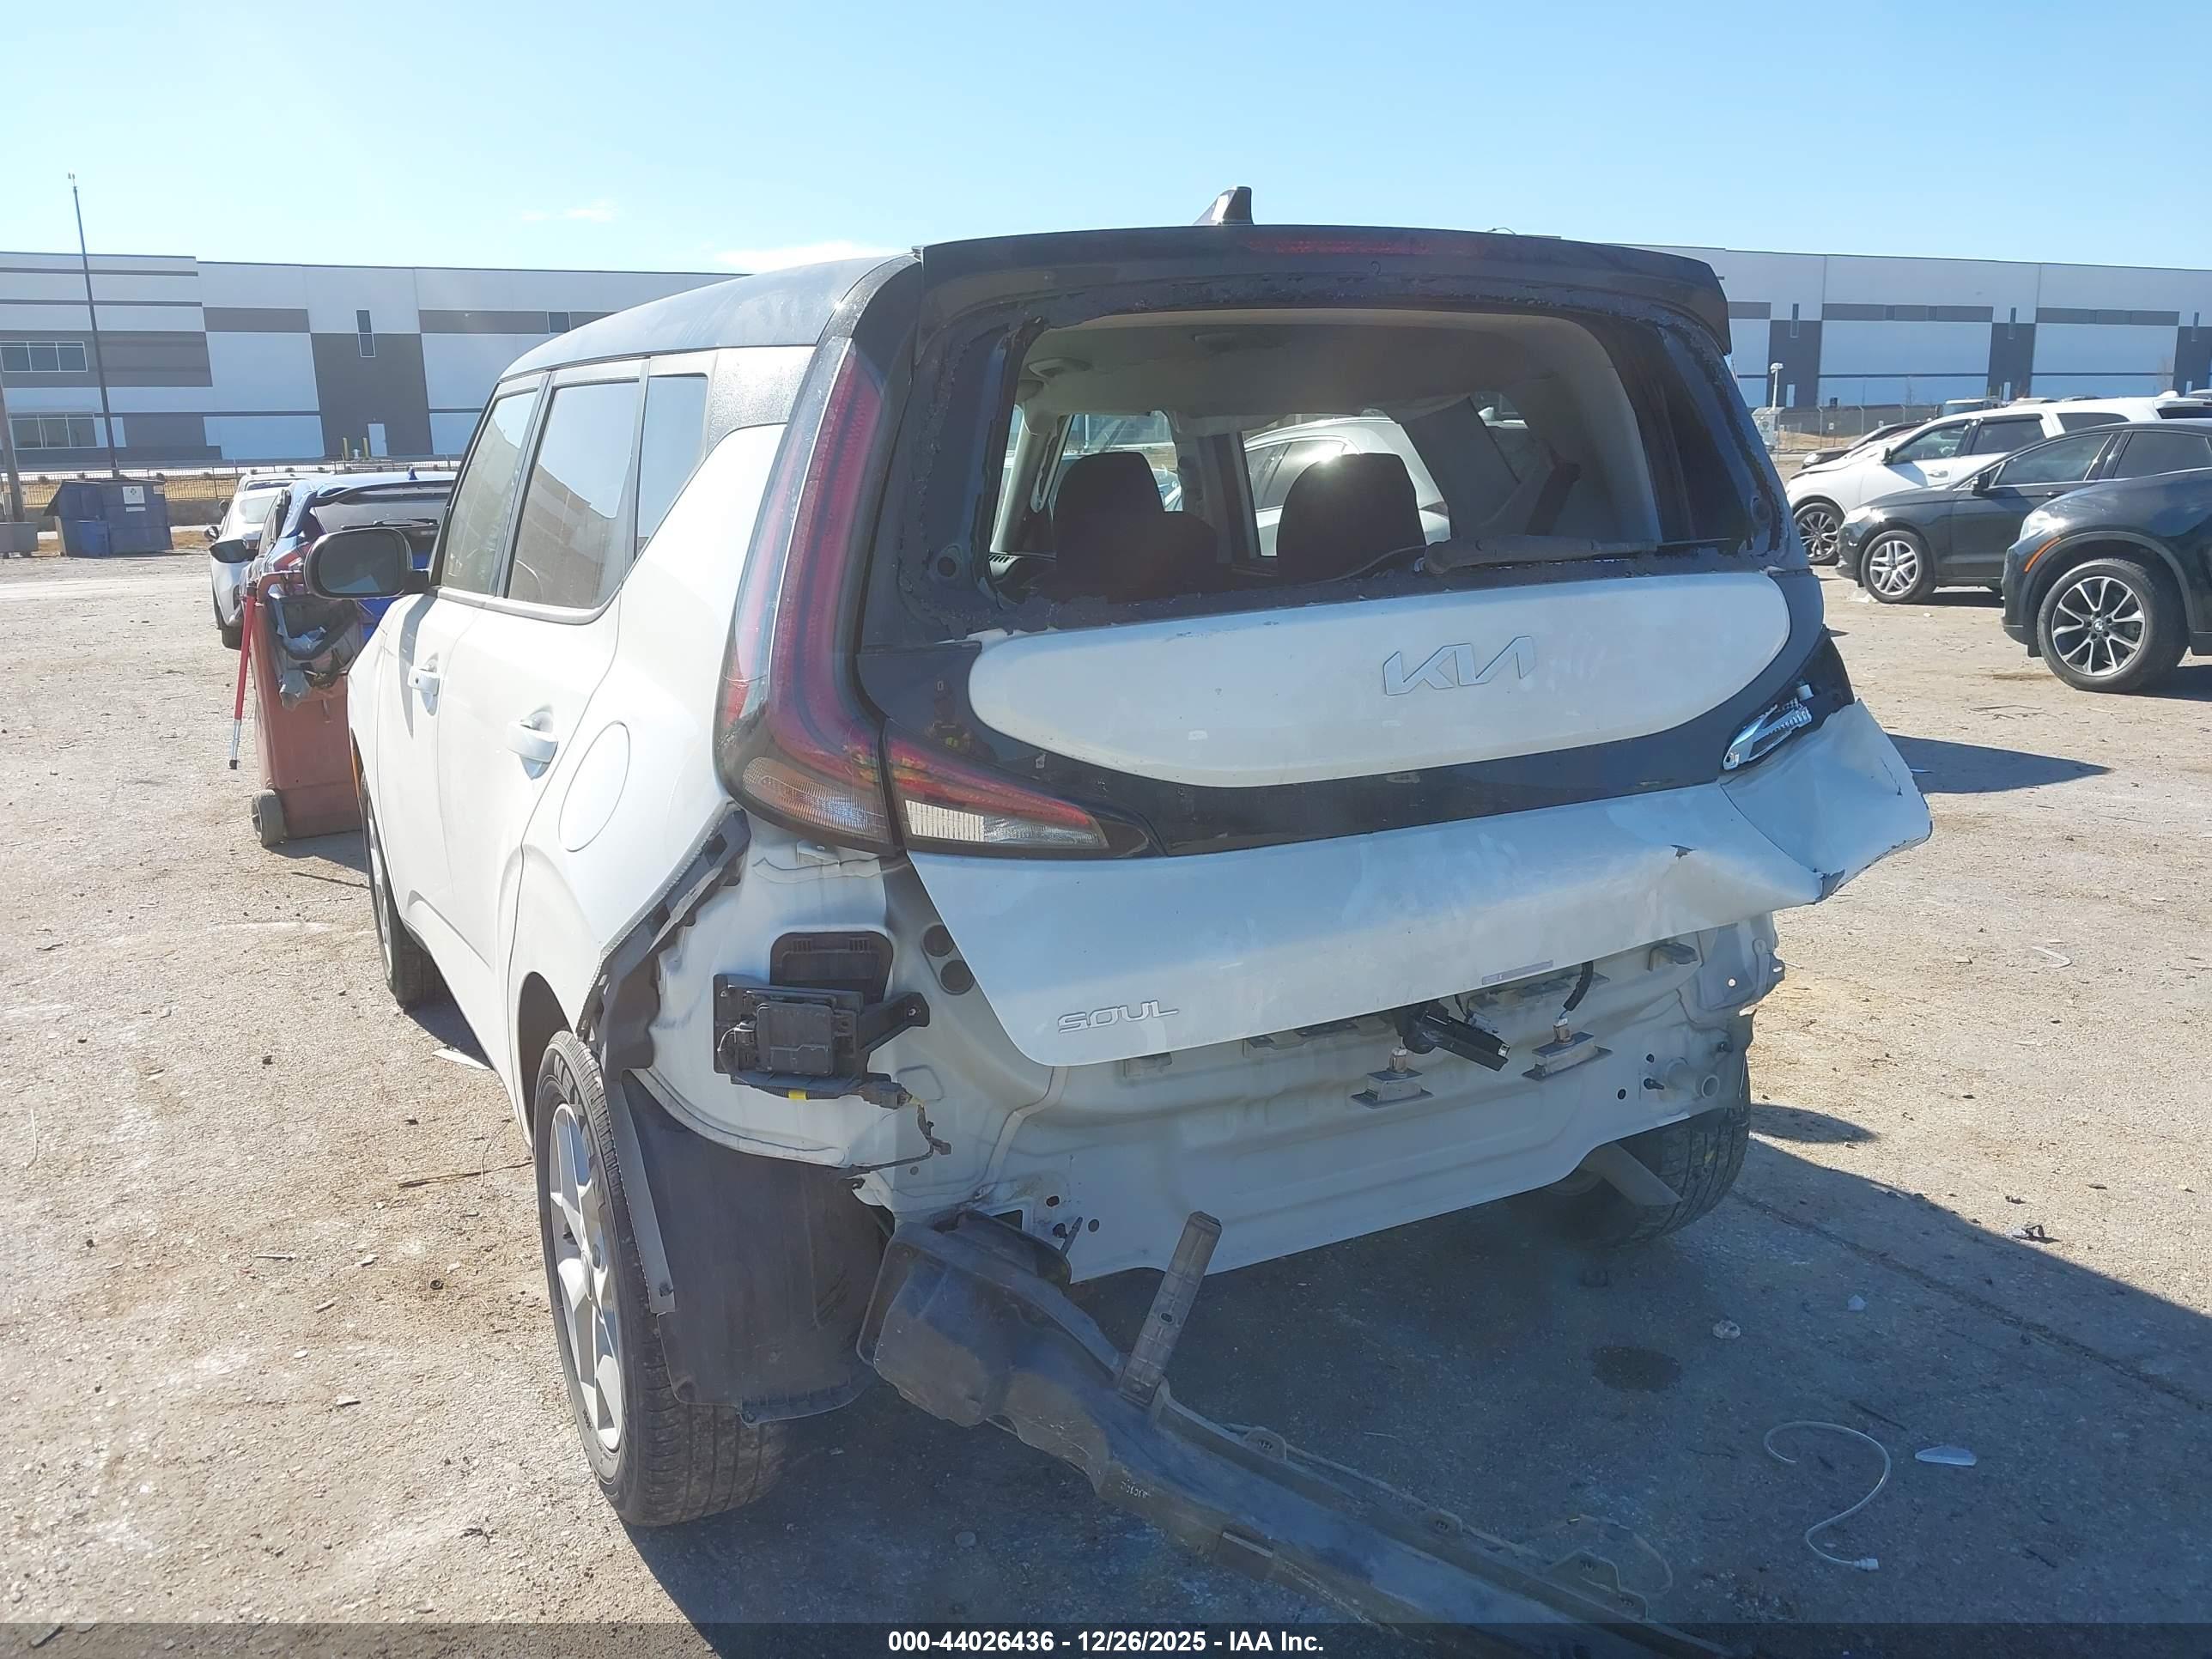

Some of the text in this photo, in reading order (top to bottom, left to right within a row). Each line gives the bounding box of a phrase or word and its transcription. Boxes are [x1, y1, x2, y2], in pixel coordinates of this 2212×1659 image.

[1382, 635, 1536, 696] KIA
[1058, 1000, 1179, 1033] SOUL
[554, 1054, 606, 1211] NEXEN
